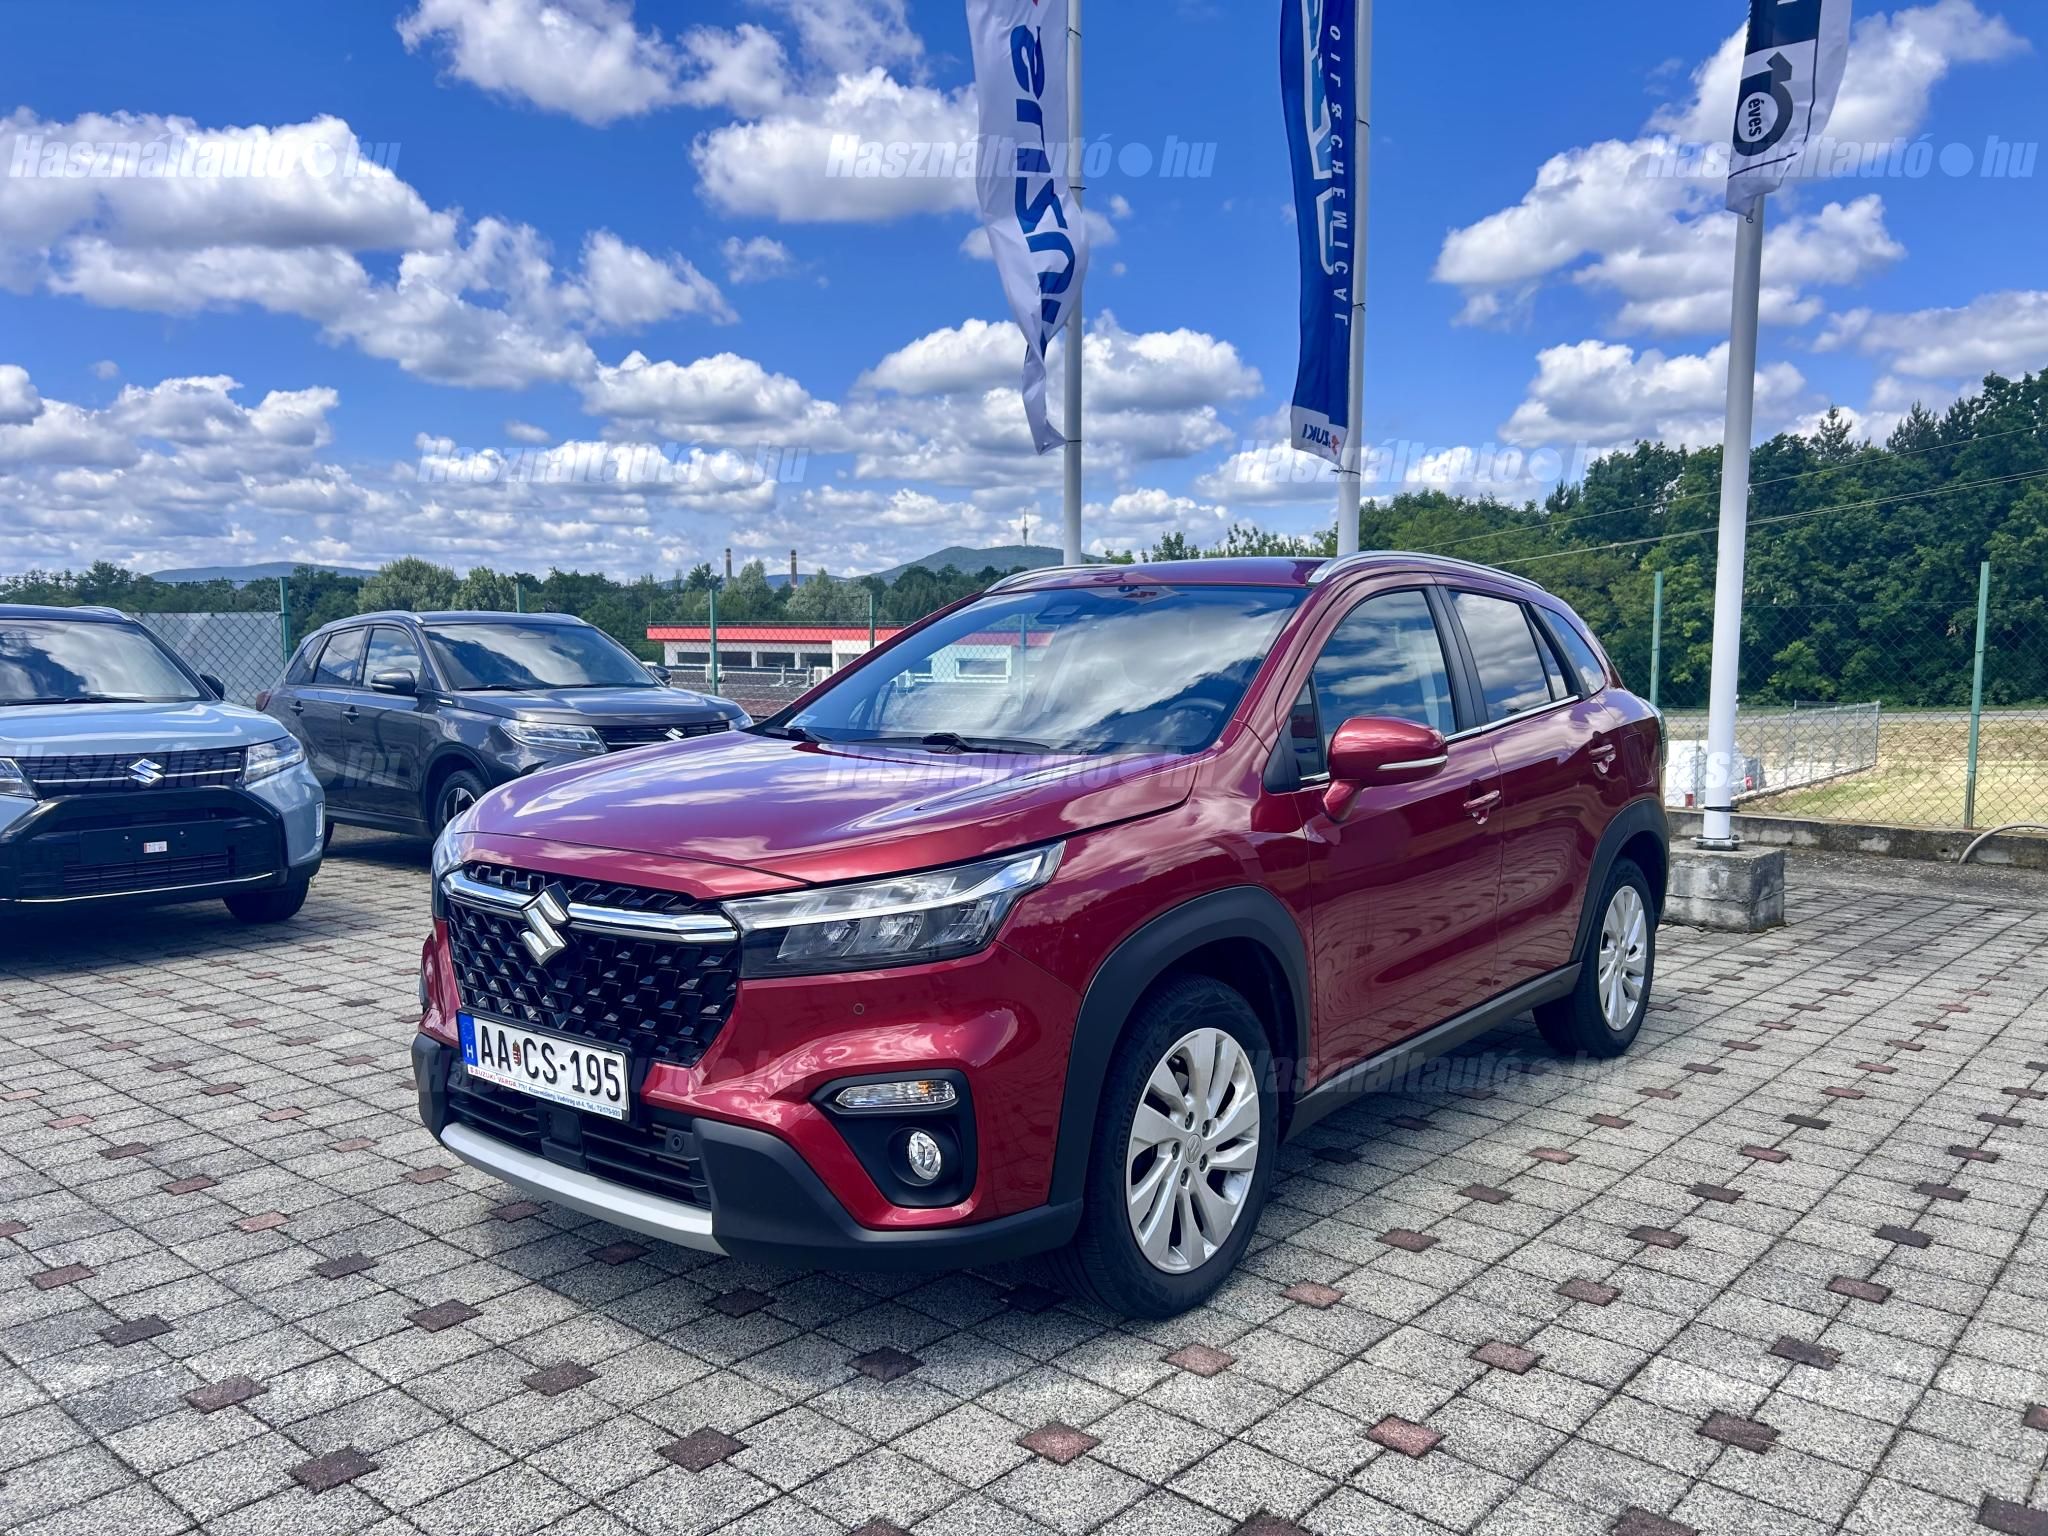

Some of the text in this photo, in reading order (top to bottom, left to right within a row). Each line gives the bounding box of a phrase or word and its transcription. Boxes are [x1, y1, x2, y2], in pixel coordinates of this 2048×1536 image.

[1748, 97, 1764, 138] éves
[466, 1044, 474, 1060] H
[474, 1069, 496, 1080] SUZUKI
